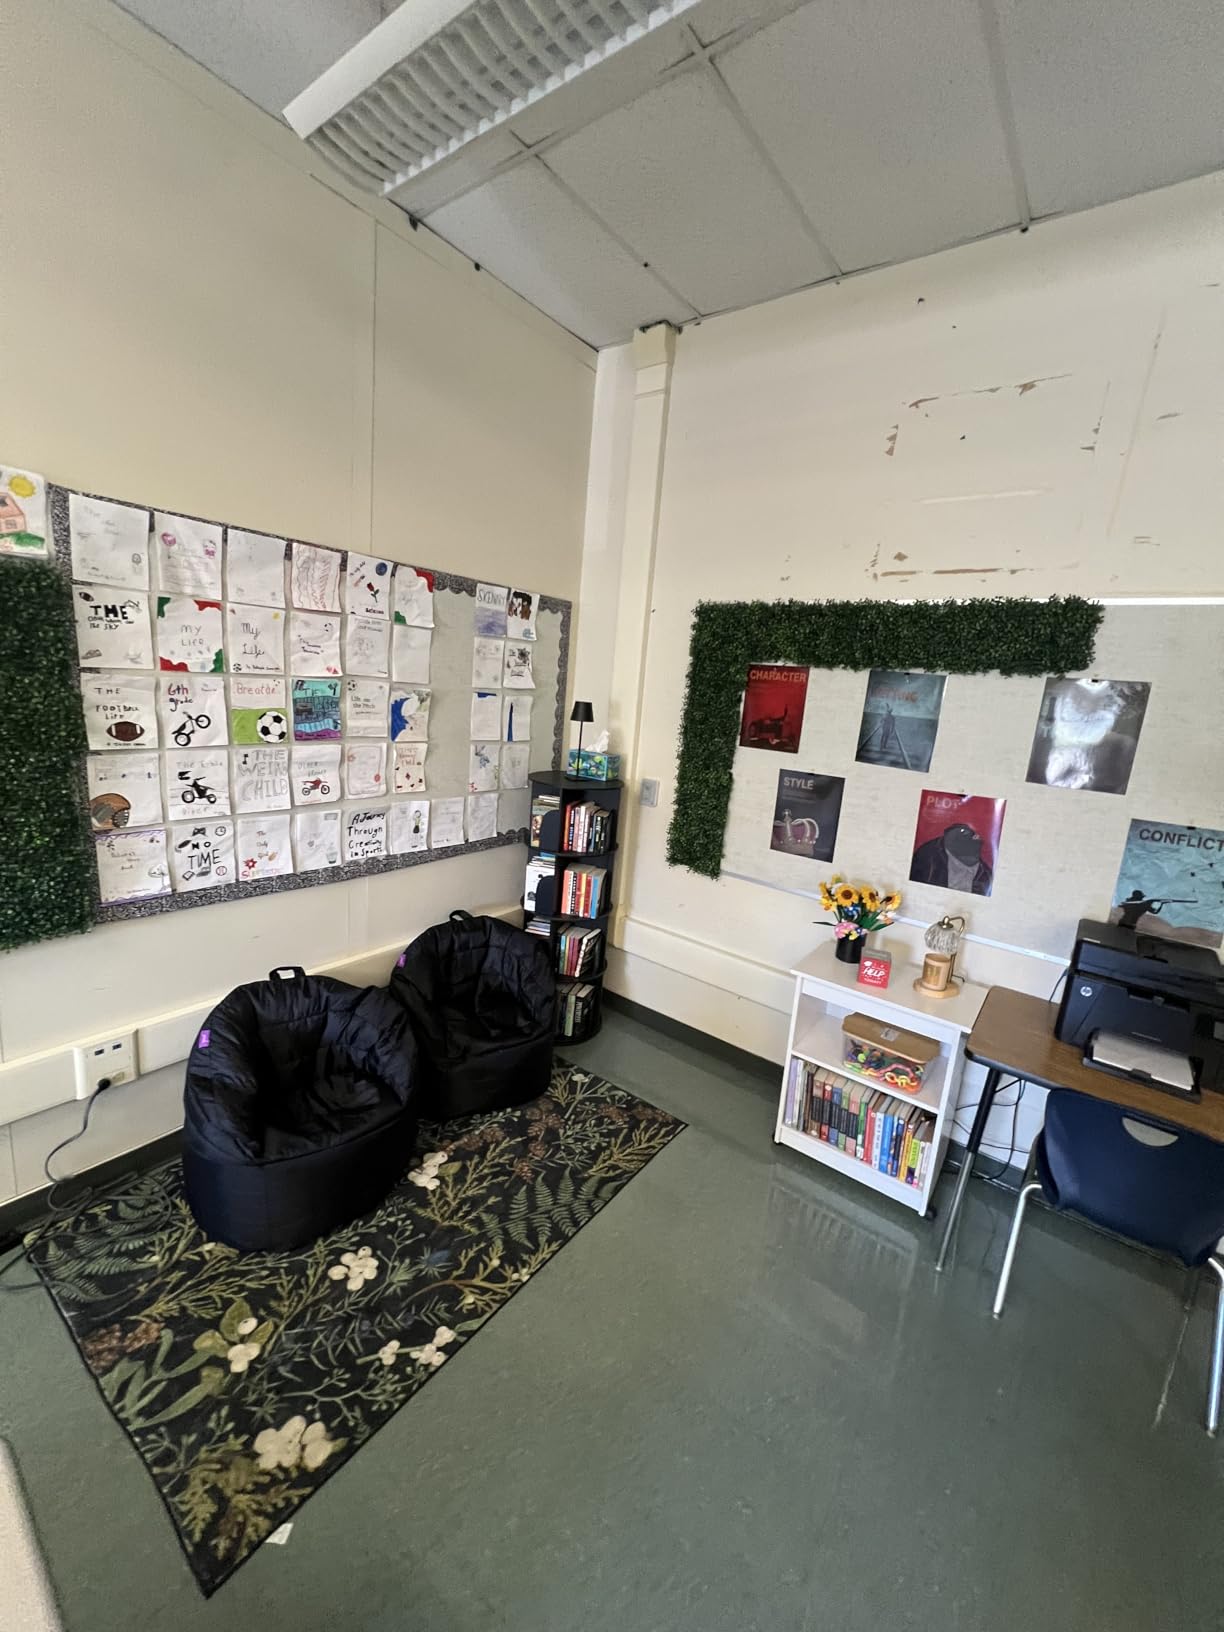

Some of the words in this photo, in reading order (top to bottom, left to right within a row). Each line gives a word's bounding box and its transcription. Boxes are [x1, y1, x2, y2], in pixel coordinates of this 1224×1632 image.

[90, 605, 132, 622] THE
[750, 670, 807, 682] CHARACTER
[95, 687, 121, 695] THE
[167, 683, 189, 696] 6th
[251, 749, 286, 761] THE
[242, 778, 288, 800] CHILD
[783, 776, 815, 790] STYLE
[926, 795, 960, 809] PLOT
[352, 813, 361, 825] A
[347, 826, 382, 838] Through
[191, 841, 211, 850] NO
[1139, 829, 1224, 852] CONFLICT
[188, 849, 221, 869] TIME
[863, 966, 886, 977] HELP
